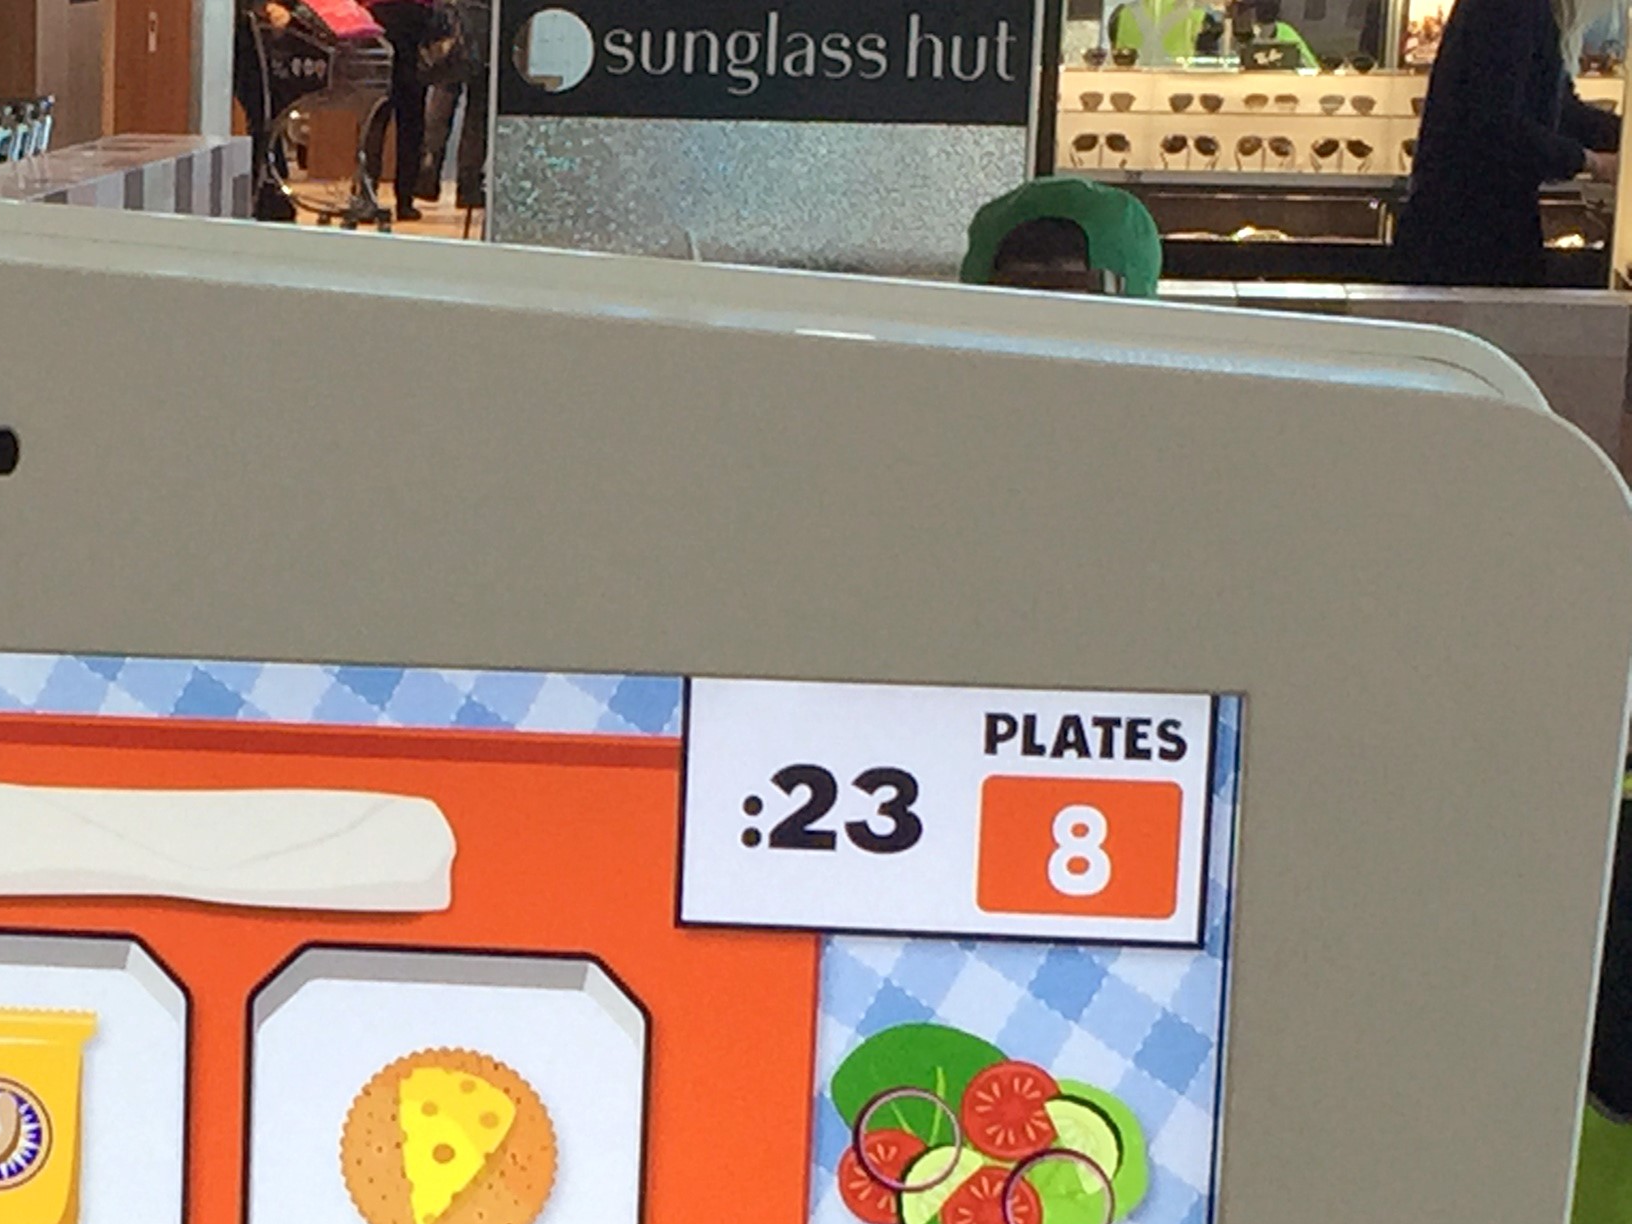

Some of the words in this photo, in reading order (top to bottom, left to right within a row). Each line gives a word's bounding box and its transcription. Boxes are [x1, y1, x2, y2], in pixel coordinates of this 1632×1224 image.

[603, 11, 888, 96] sunglass
[906, 13, 1017, 82] hut
[982, 712, 1188, 762] PLATES
[740, 763, 924, 854] :23
[1046, 804, 1112, 897] 8
